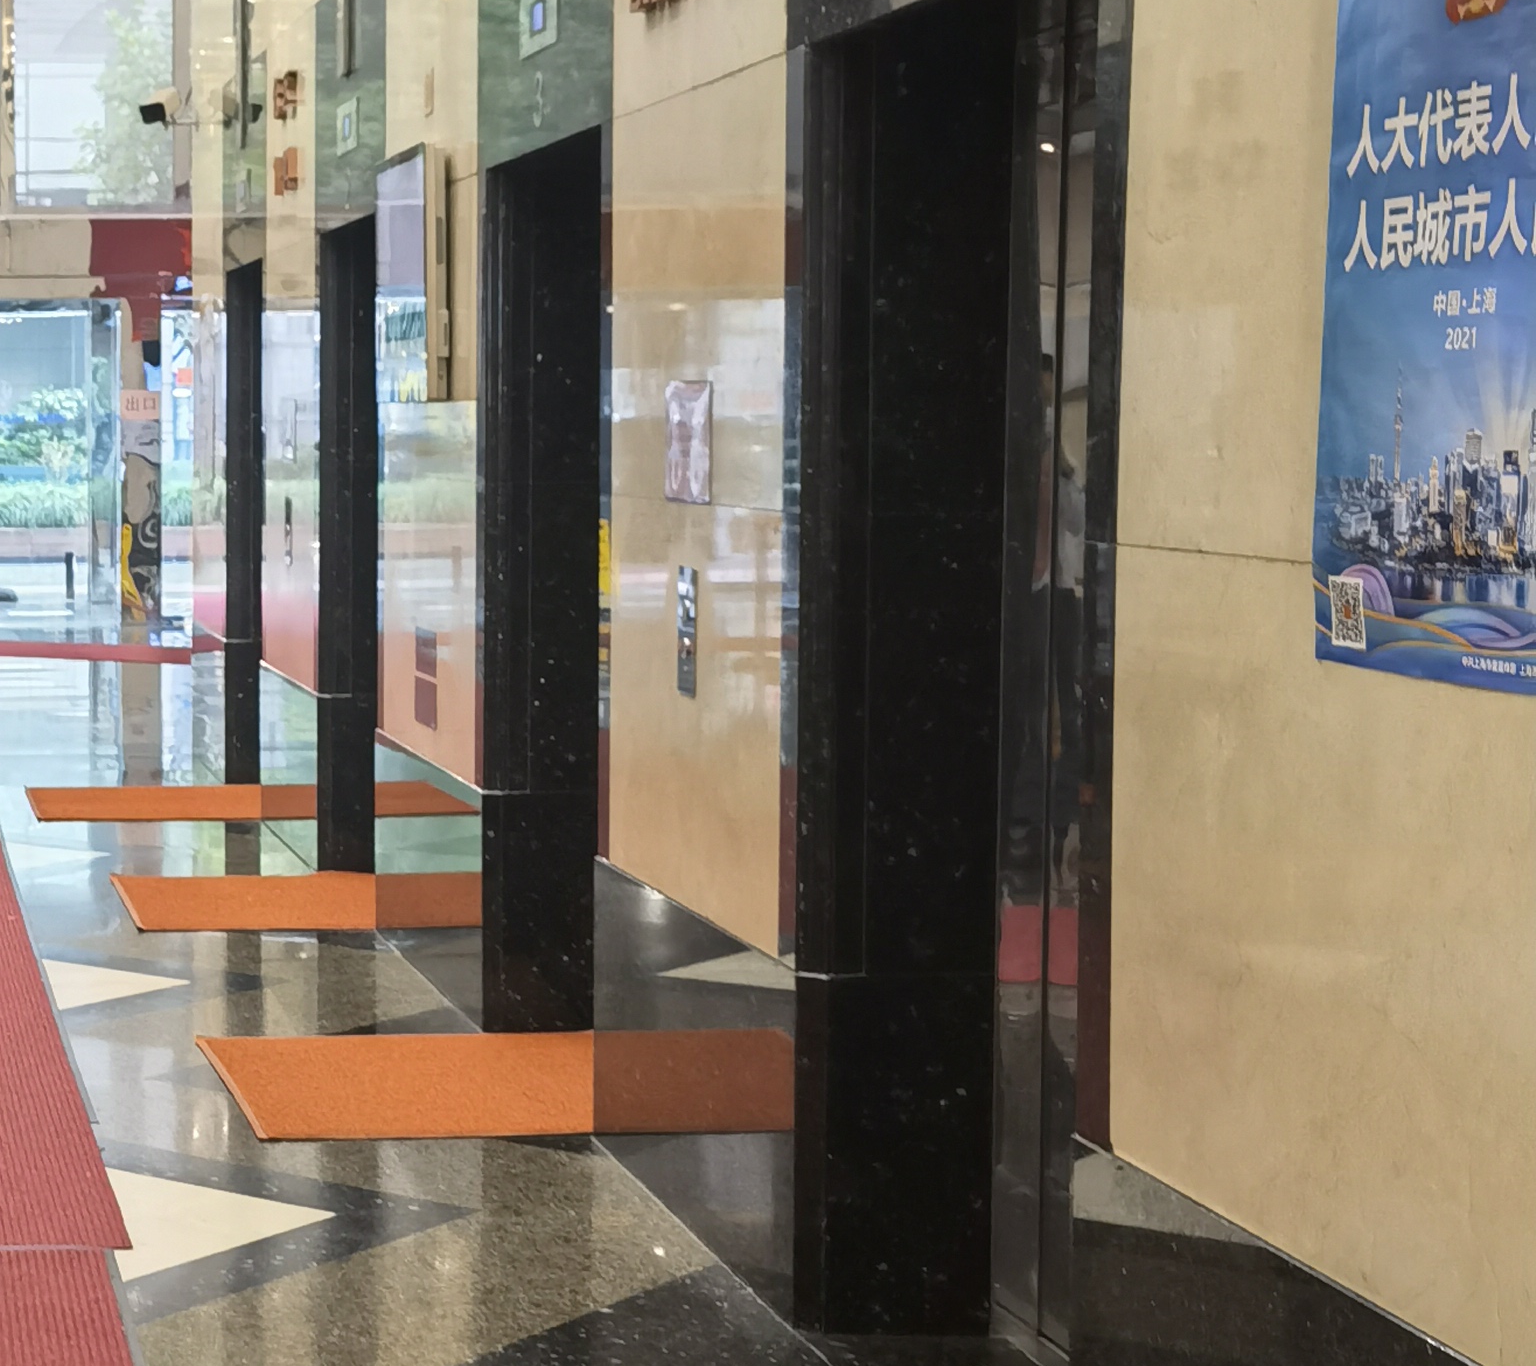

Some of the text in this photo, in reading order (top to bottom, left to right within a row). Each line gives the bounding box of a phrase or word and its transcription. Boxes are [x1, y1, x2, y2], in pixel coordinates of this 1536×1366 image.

[1346, 71, 1536, 180] 人大代表人
[1342, 176, 1536, 274] 人民城市人
[1444, 325, 1478, 351] 2021
[125, 394, 157, 412] 出口
